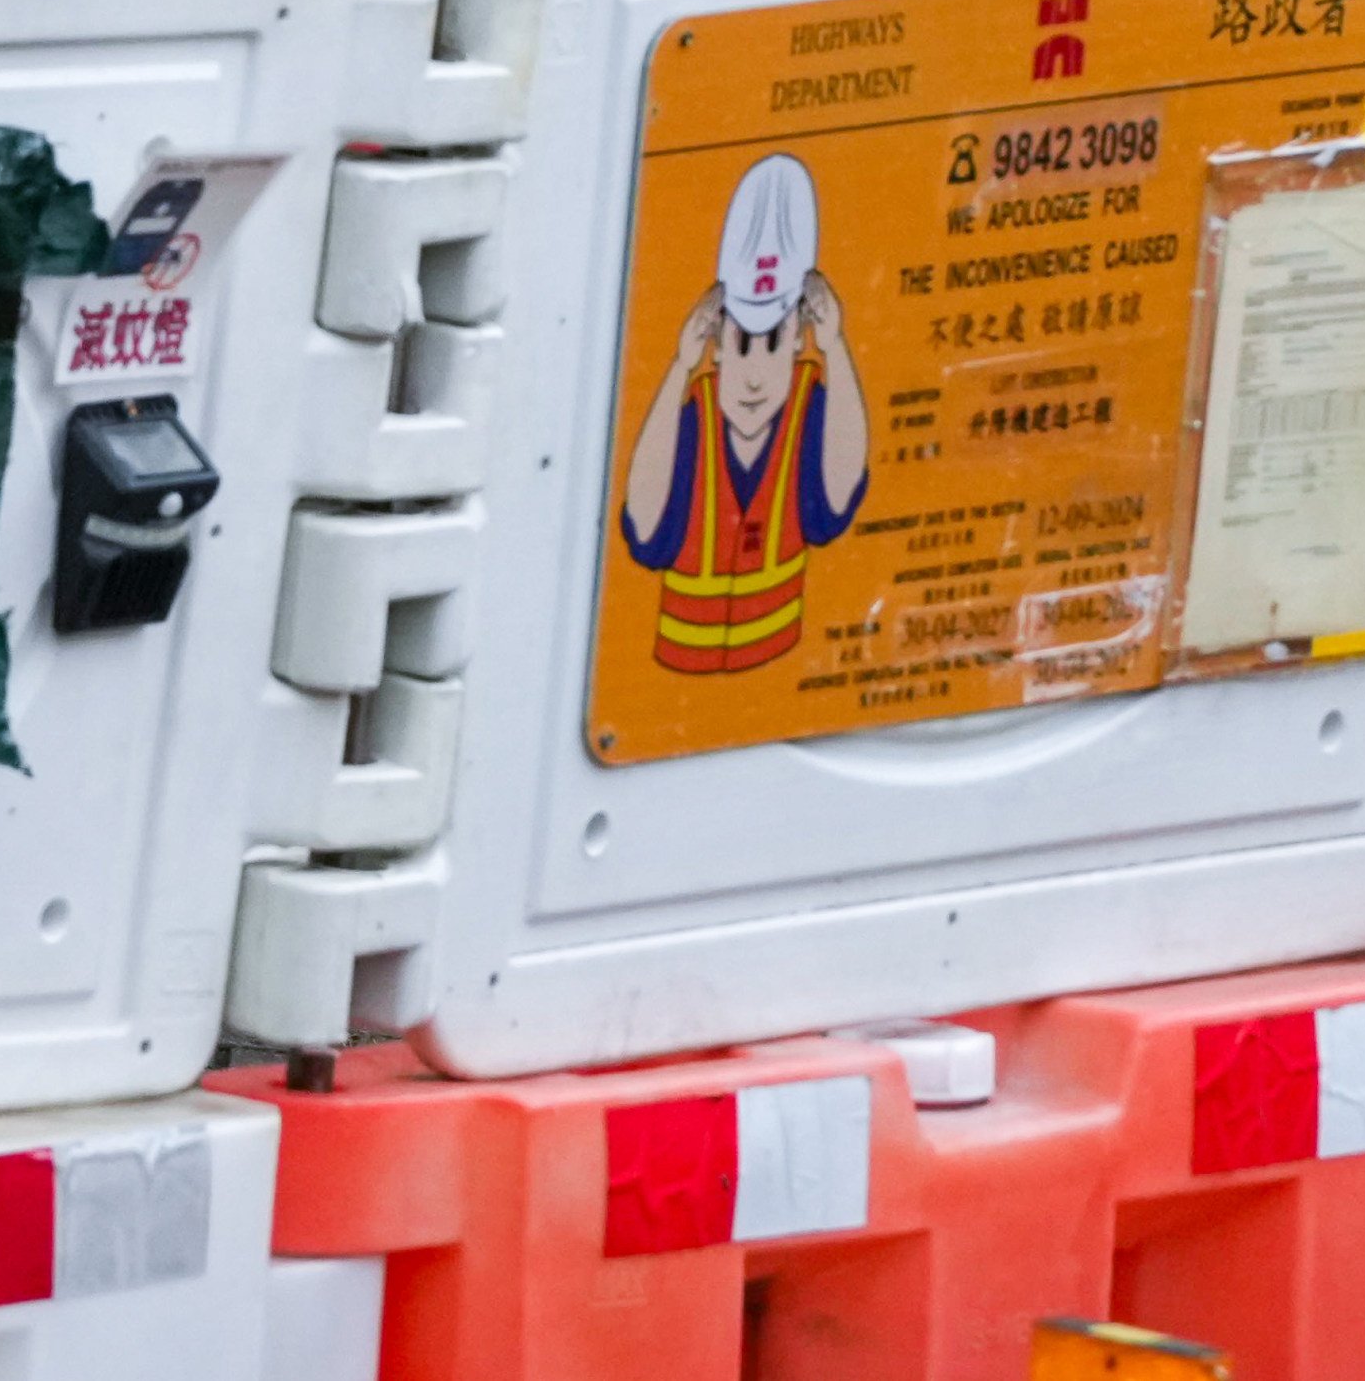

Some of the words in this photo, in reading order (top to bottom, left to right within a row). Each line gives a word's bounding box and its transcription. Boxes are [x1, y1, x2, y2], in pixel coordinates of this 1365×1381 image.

[790, 11, 906, 56] HIGHWAYS
[769, 64, 916, 113] DEPARTMENT
[993, 125, 1074, 180] 9842
[1079, 116, 1160, 170] 3098
[947, 204, 975, 236] WE
[986, 191, 1091, 231] APOLOGIZE
[1102, 183, 1141, 216] FOR
[899, 264, 935, 296] THE
[945, 243, 1093, 290] INCONVENIENCE
[1104, 232, 1179, 270] CAUSED
